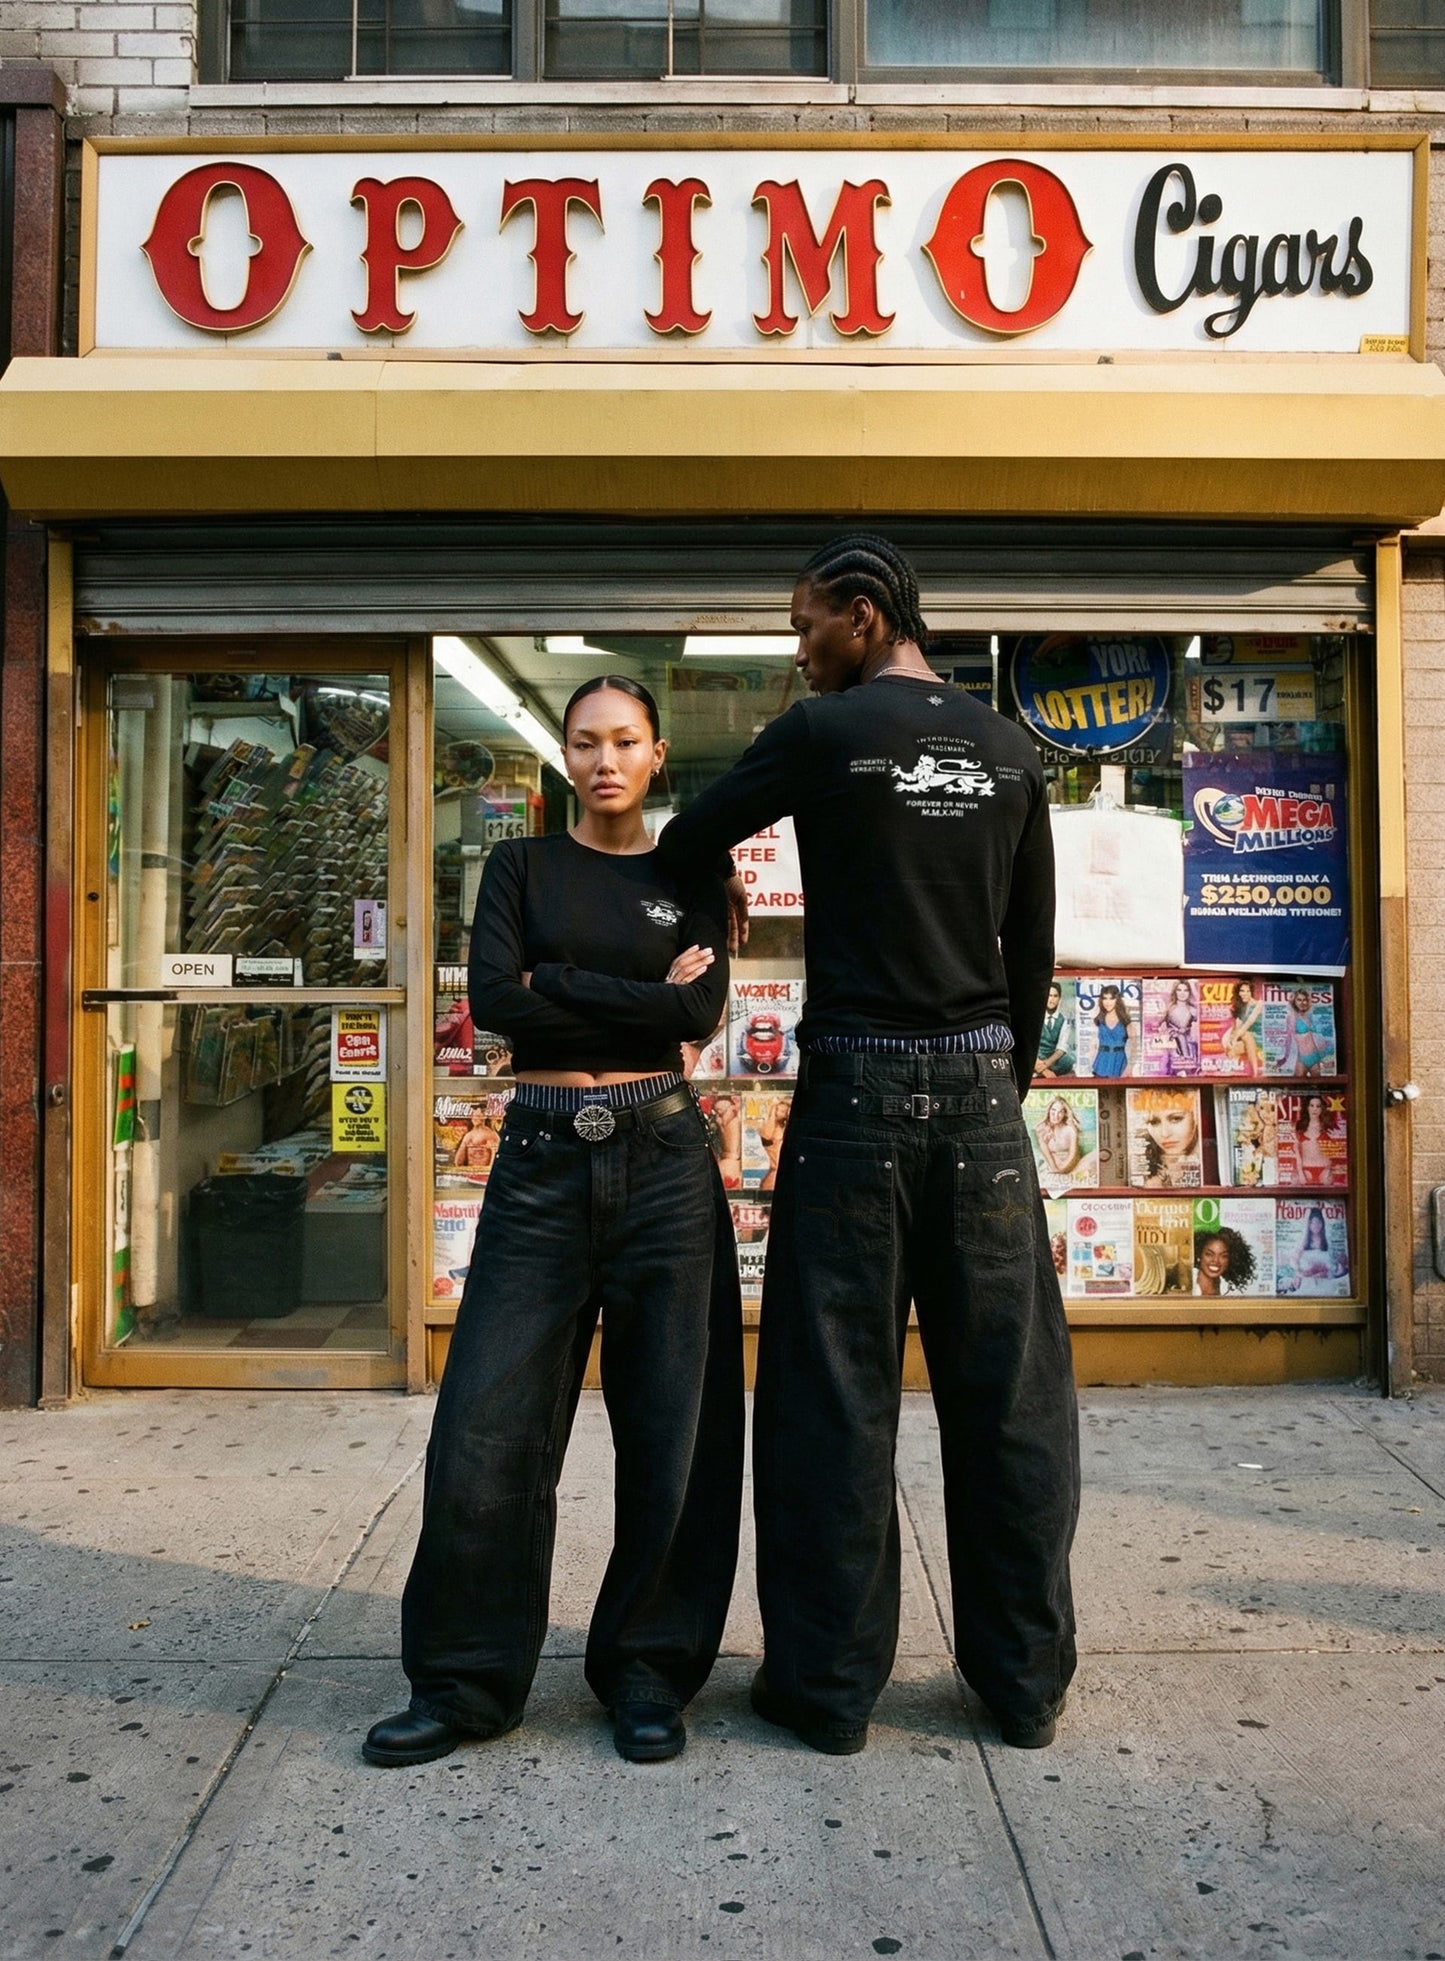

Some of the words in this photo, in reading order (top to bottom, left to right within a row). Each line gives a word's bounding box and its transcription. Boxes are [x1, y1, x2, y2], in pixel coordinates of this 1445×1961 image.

[139, 159, 1094, 337] OPTIMO
[1134, 163, 1373, 339] Cigars
[1203, 676, 1275, 714] $17
[906, 800, 941, 808] FOREVER
[955, 801, 979, 810] NEVER
[1240, 794, 1334, 831] MEGA
[1201, 884, 1331, 907] $250,000
[171, 963, 215, 976] OPEN
[1196, 1199, 1218, 1223] O
